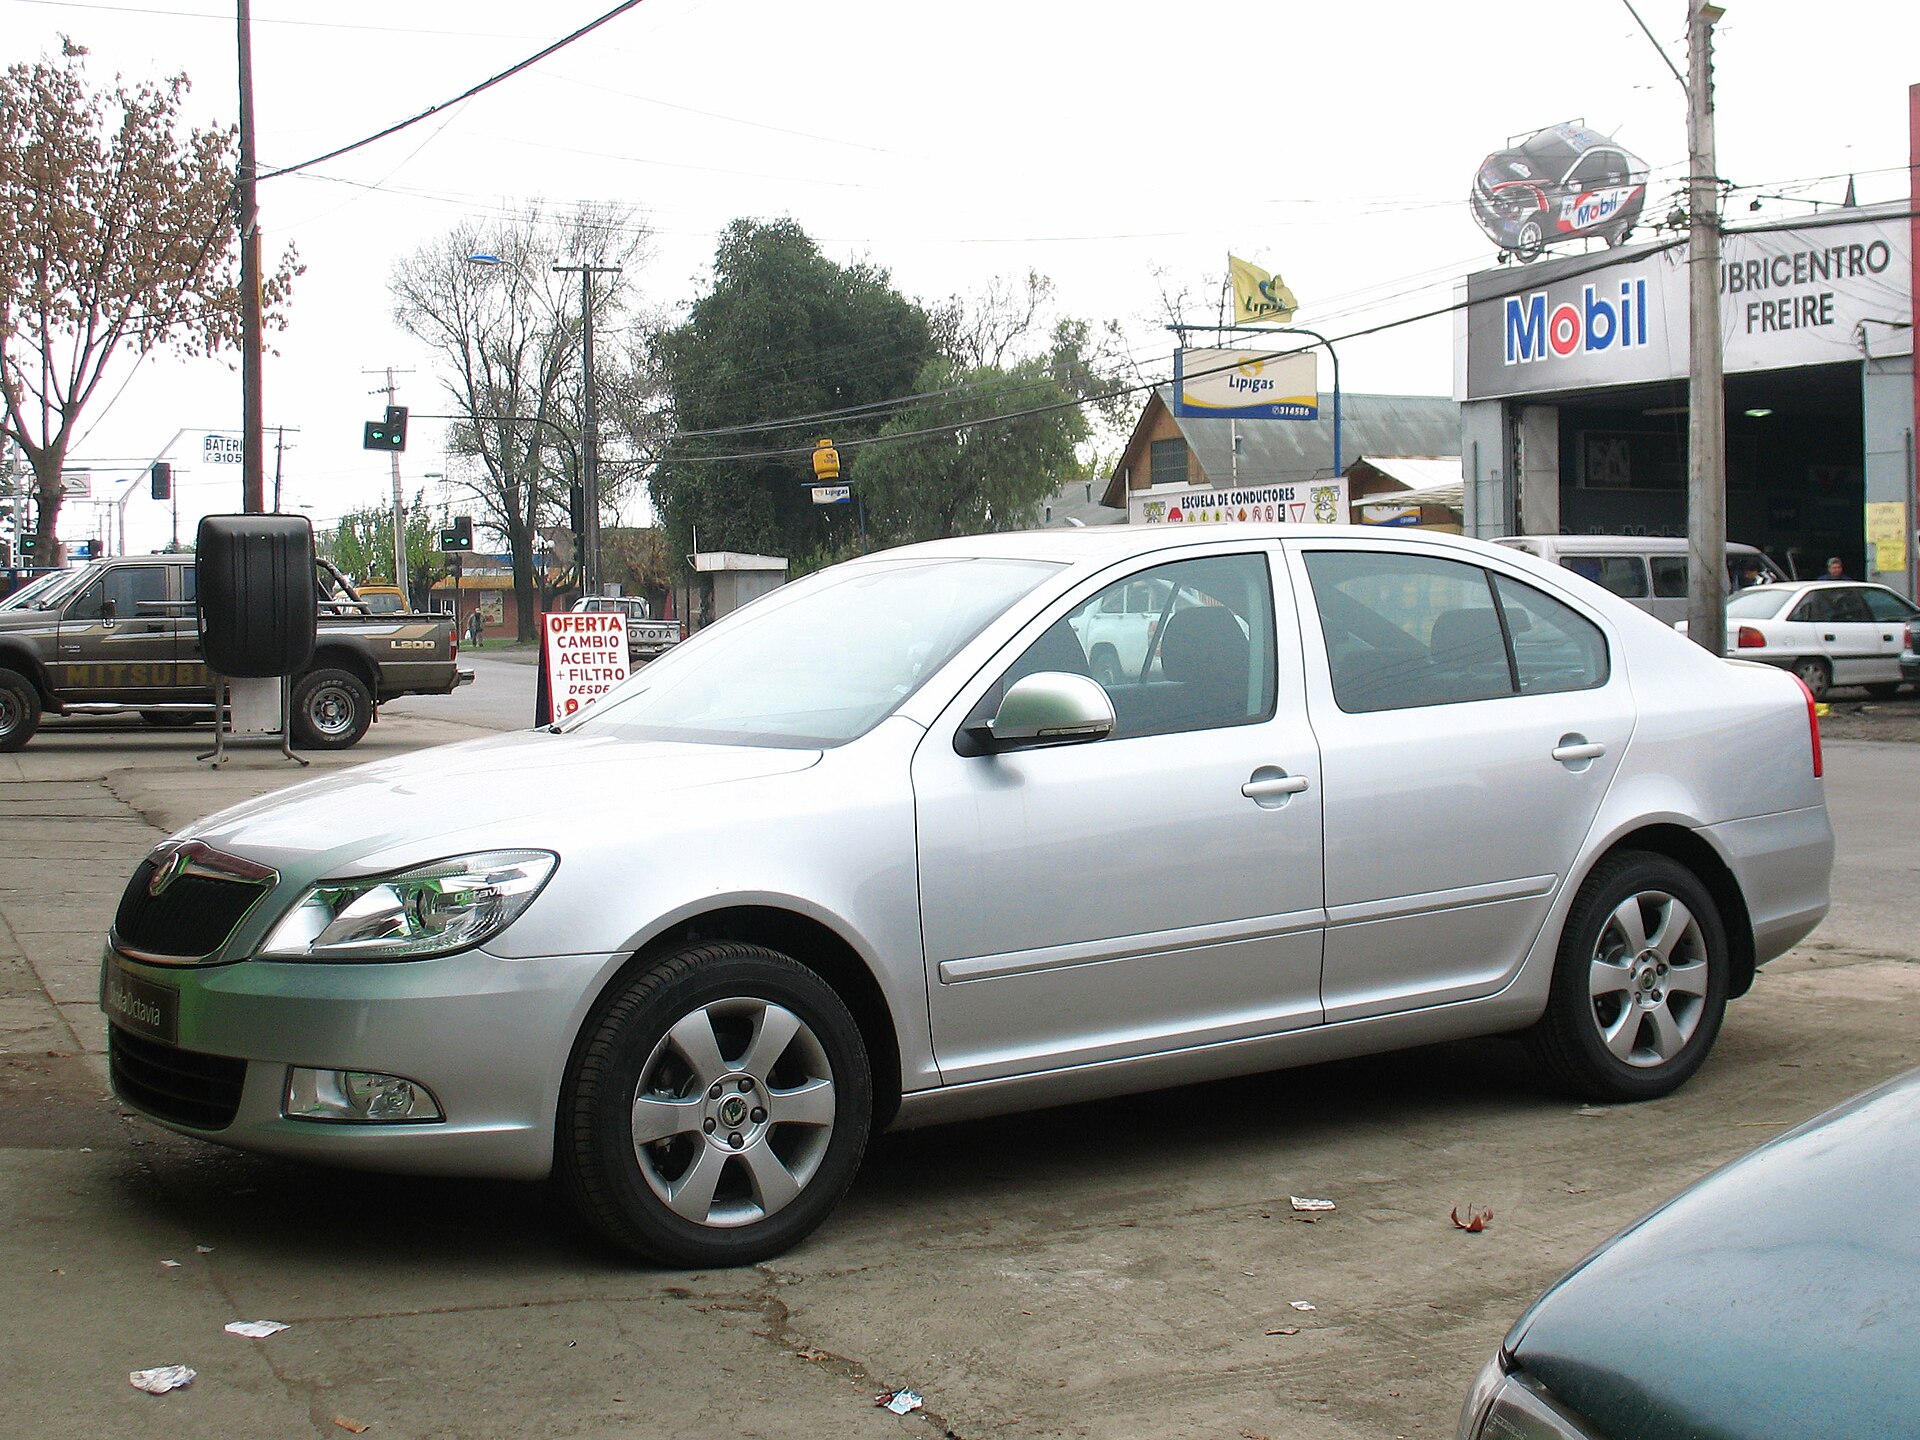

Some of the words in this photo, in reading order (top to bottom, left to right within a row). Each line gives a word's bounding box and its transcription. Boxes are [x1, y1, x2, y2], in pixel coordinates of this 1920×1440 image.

[1577, 191, 1617, 227] Mobil
[1505, 277, 1648, 364] Mobil
[1747, 292, 1835, 334] FREIRE
[1229, 374, 1275, 392] Lipigas
[206, 438, 243, 452] BATERI
[1181, 494, 1216, 510] ESCUELA
[1218, 492, 1229, 506] DE
[1230, 487, 1295, 505] CONDUCTORES
[550, 616, 622, 634] OFERTA
[390, 640, 436, 649] L200
[557, 636, 619, 649] CAMBIO
[561, 652, 618, 665] ACEITE
[569, 668, 625, 681] FILTRO
[569, 685, 610, 695] DESDE
[128, 992, 161, 1026] Octavia
